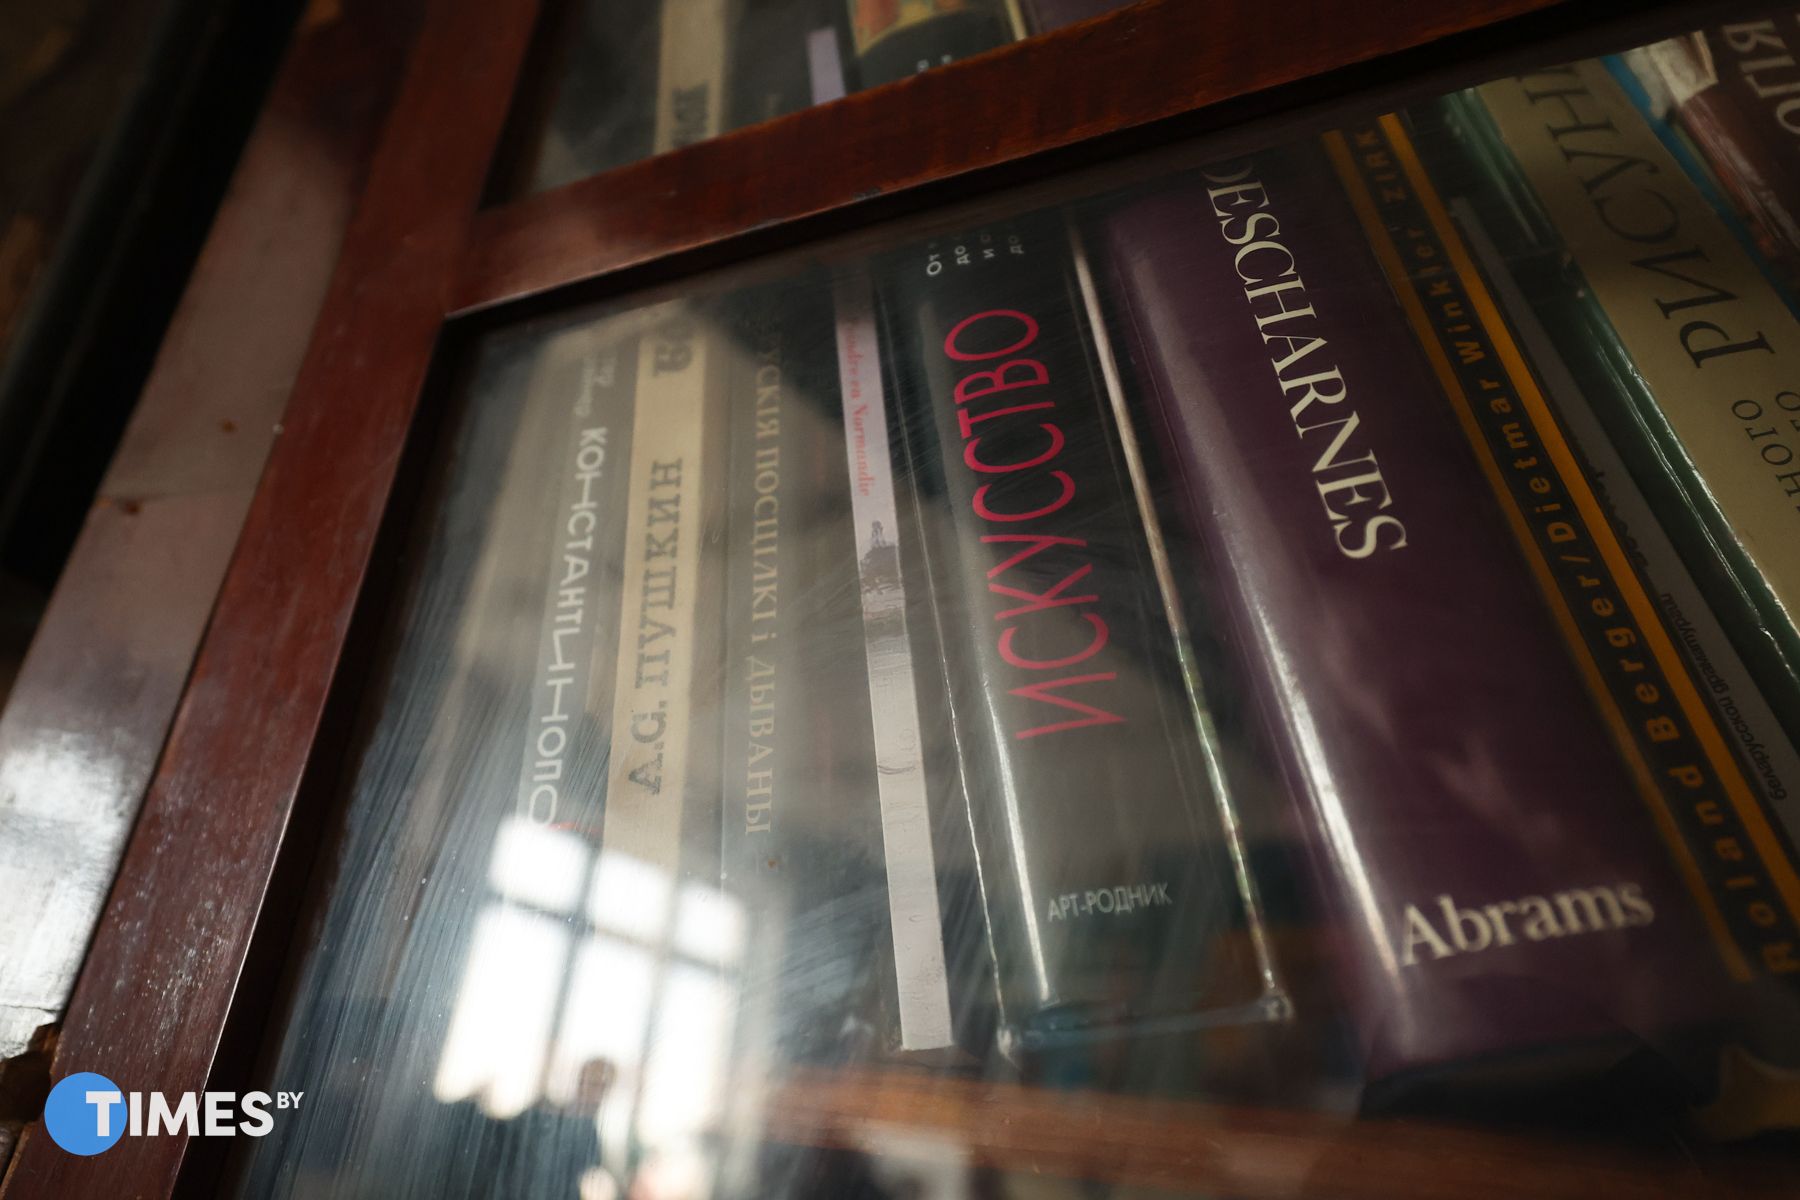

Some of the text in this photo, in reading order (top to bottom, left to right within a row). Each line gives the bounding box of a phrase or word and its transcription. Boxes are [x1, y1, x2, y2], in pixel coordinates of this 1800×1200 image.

[1406, 226, 1485, 366] Winkler
[634, 456, 684, 689] ПУШКИН
[751, 444, 782, 630] ПОСЦІЛКІ
[944, 308, 1128, 741] ИСКУССТВО
[528, 426, 608, 828] КОНСТАНТИНОПО
[744, 654, 776, 835] ДЫВАНЫ
[1047, 881, 1172, 923] АРТ-РОДНИК
[1401, 879, 1656, 968] Abrams
[1667, 764, 1800, 974] Roland
